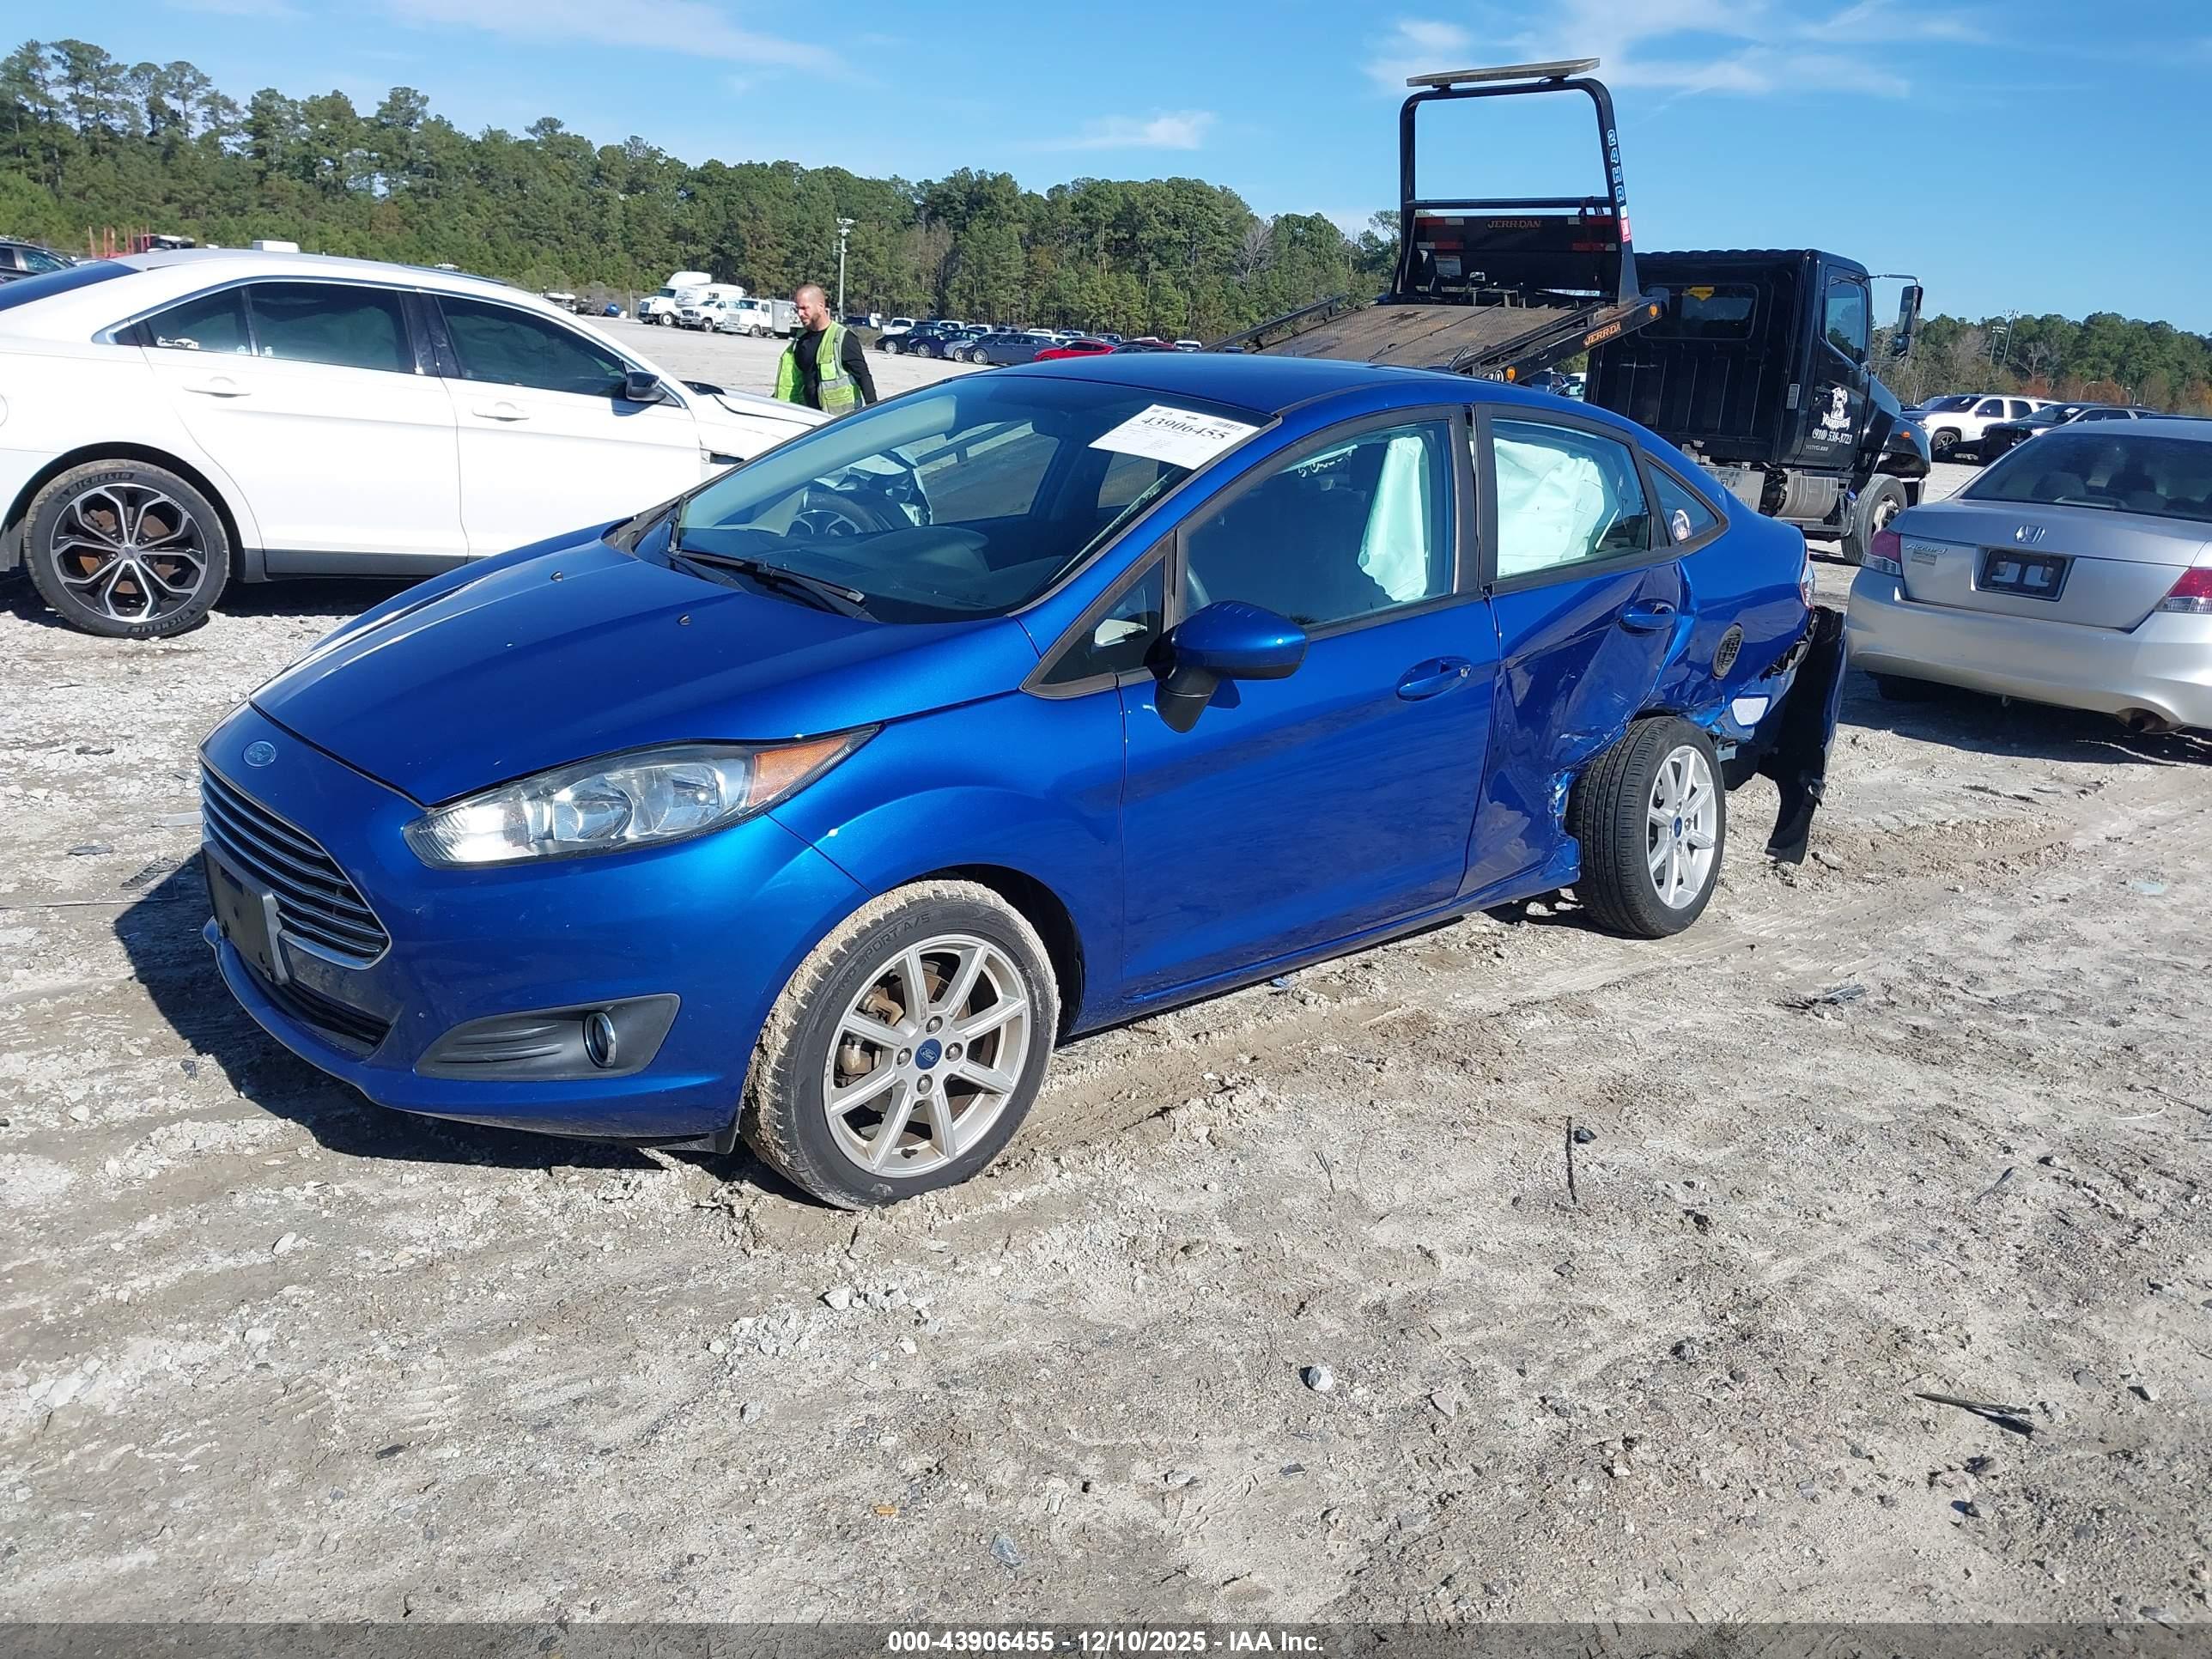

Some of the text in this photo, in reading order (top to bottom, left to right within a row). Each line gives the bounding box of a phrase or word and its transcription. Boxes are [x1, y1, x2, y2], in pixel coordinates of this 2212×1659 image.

[1140, 416, 1231, 441] 43906455
[1812, 428, 1828, 441] (910)
[69, 472, 131, 496] MICHELIN
[902, 912, 931, 933] A/S
